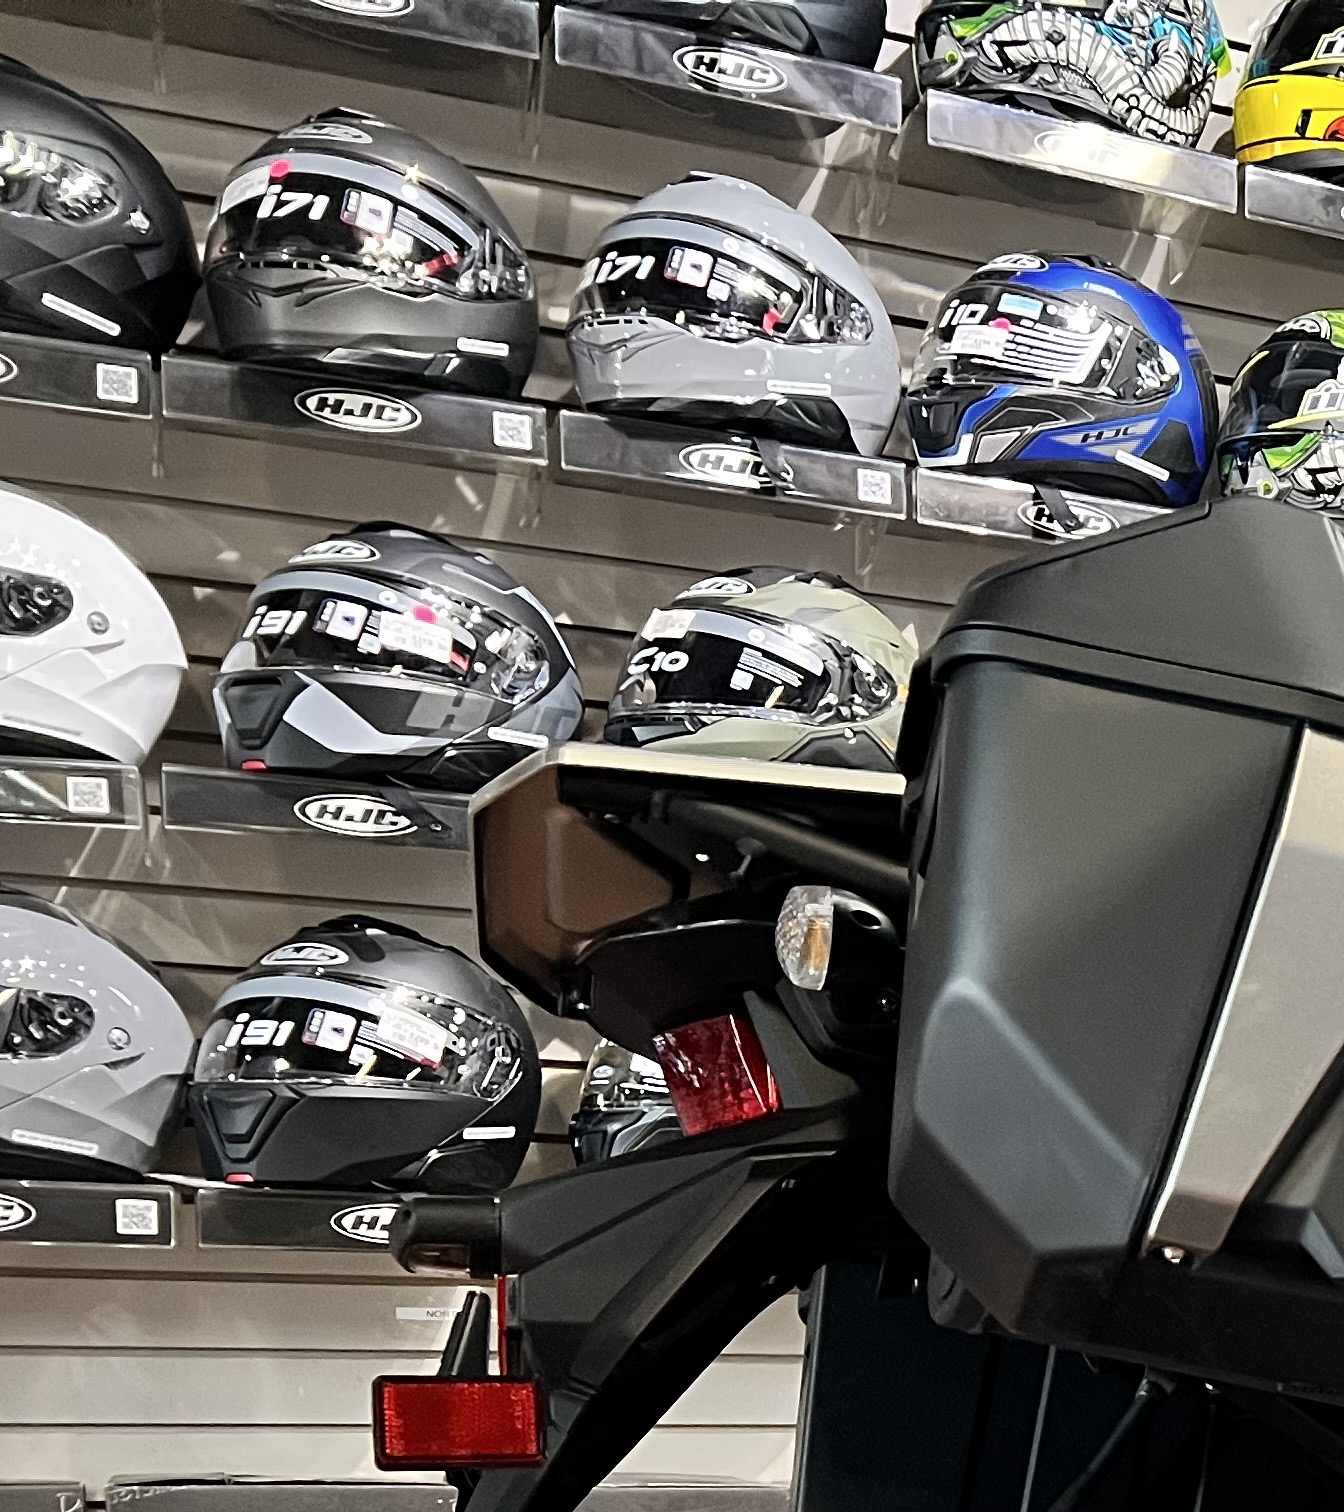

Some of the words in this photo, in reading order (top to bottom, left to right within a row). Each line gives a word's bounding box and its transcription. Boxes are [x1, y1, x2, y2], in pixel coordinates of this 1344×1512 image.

[692, 52, 770, 87] HJC
[256, 185, 330, 221] i71
[595, 251, 656, 284] i71
[312, 394, 404, 425] HJC
[1080, 425, 1141, 445] HJC
[314, 803, 401, 829] HJC
